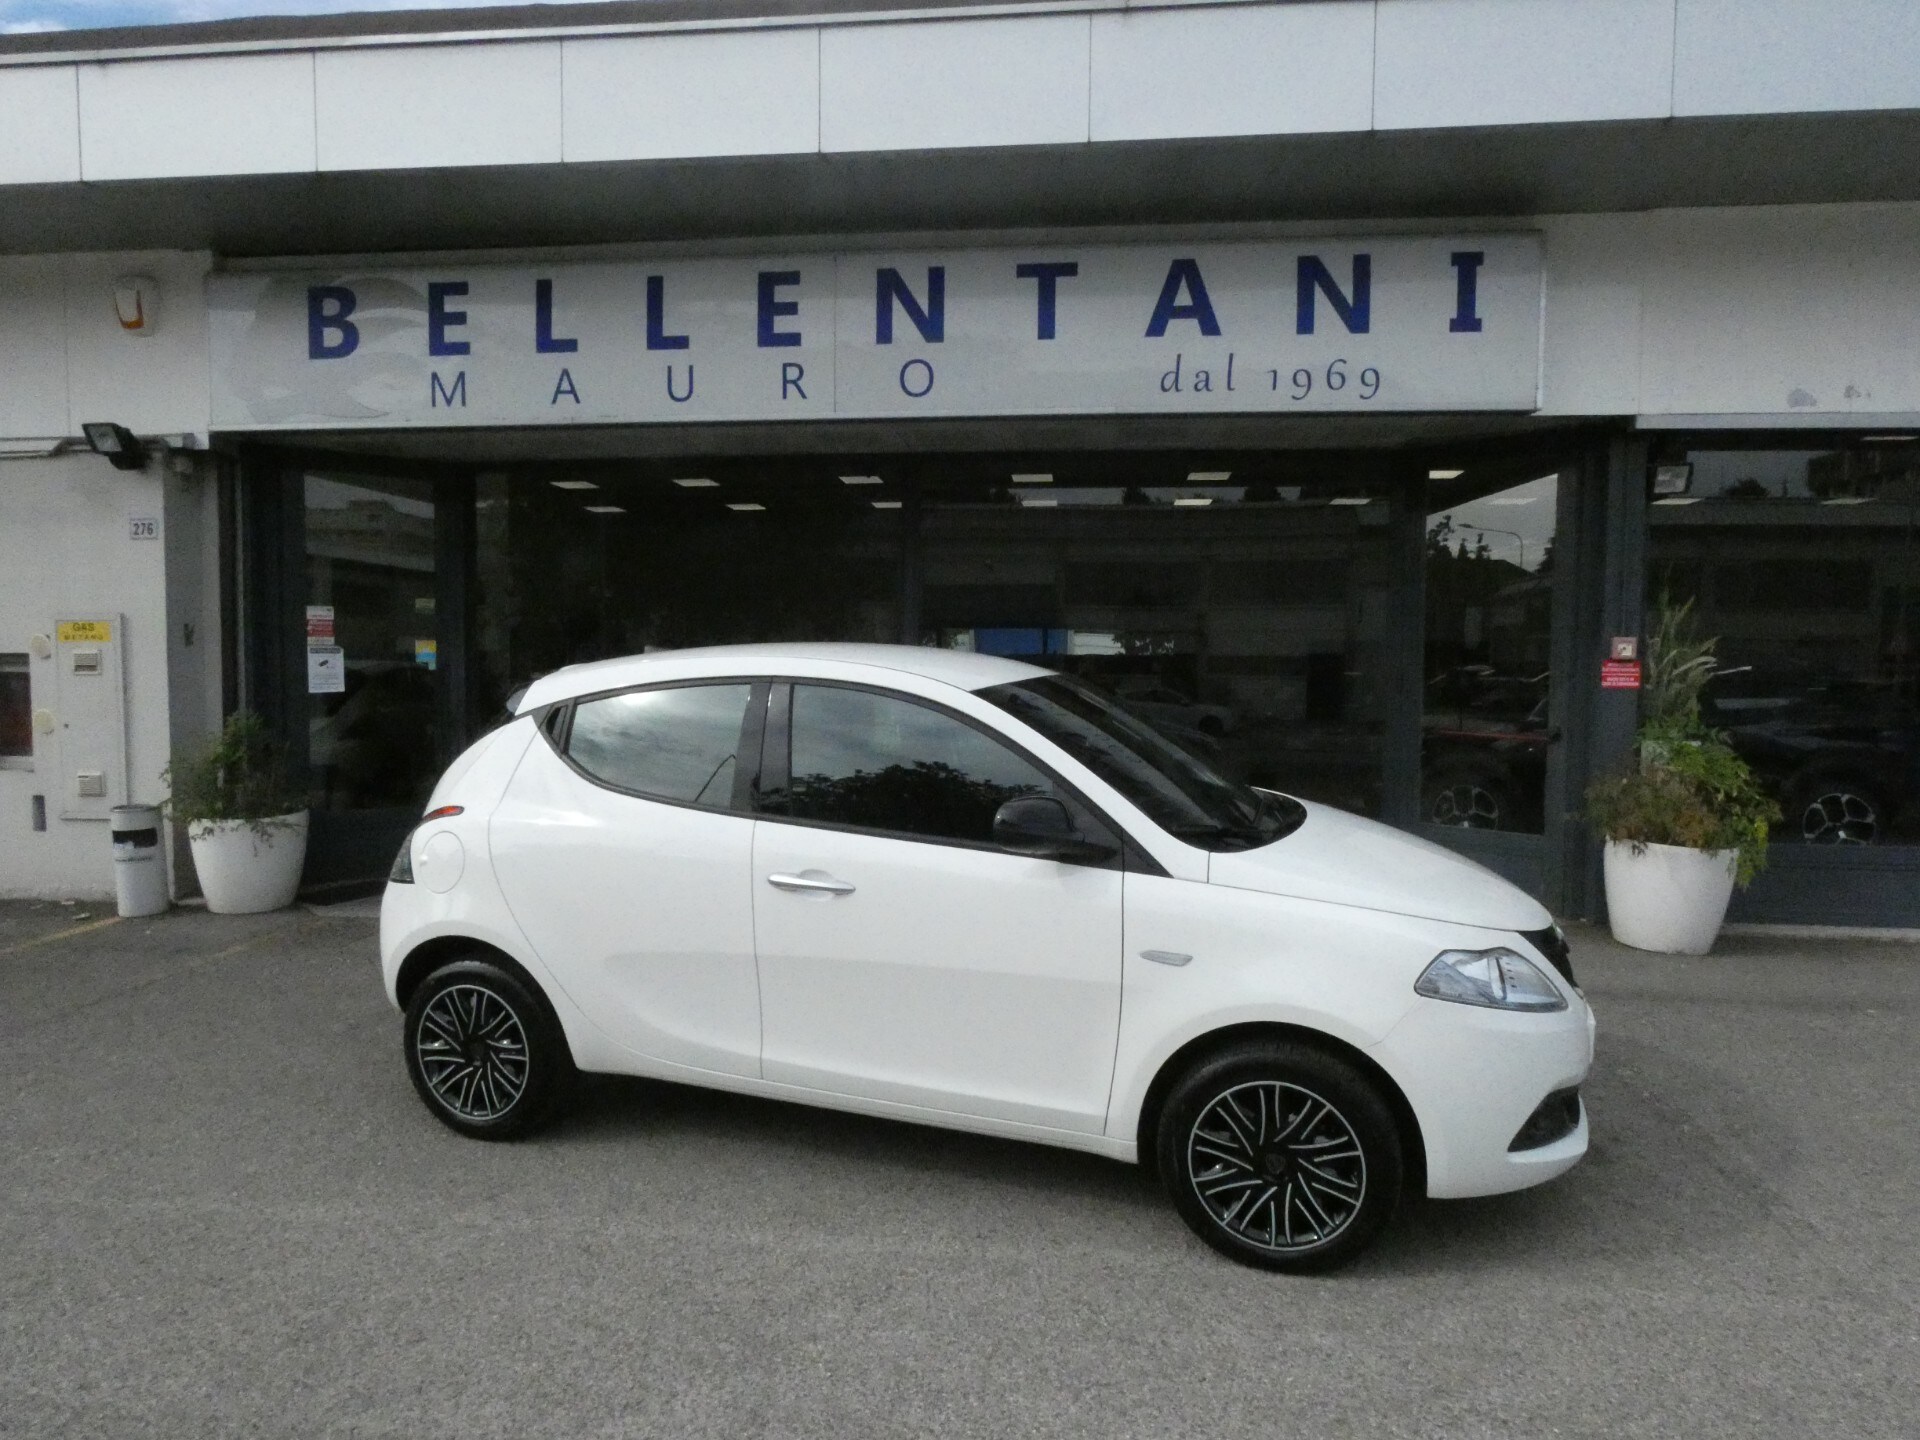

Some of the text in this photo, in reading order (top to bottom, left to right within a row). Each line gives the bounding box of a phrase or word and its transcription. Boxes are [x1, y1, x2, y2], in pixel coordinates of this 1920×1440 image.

[307, 250, 1485, 360] BELLENTANI
[430, 358, 935, 408] MAURO
[1160, 352, 1381, 401] dal 1969
[133, 522, 154, 536] 276
[72, 622, 95, 632] GAS
